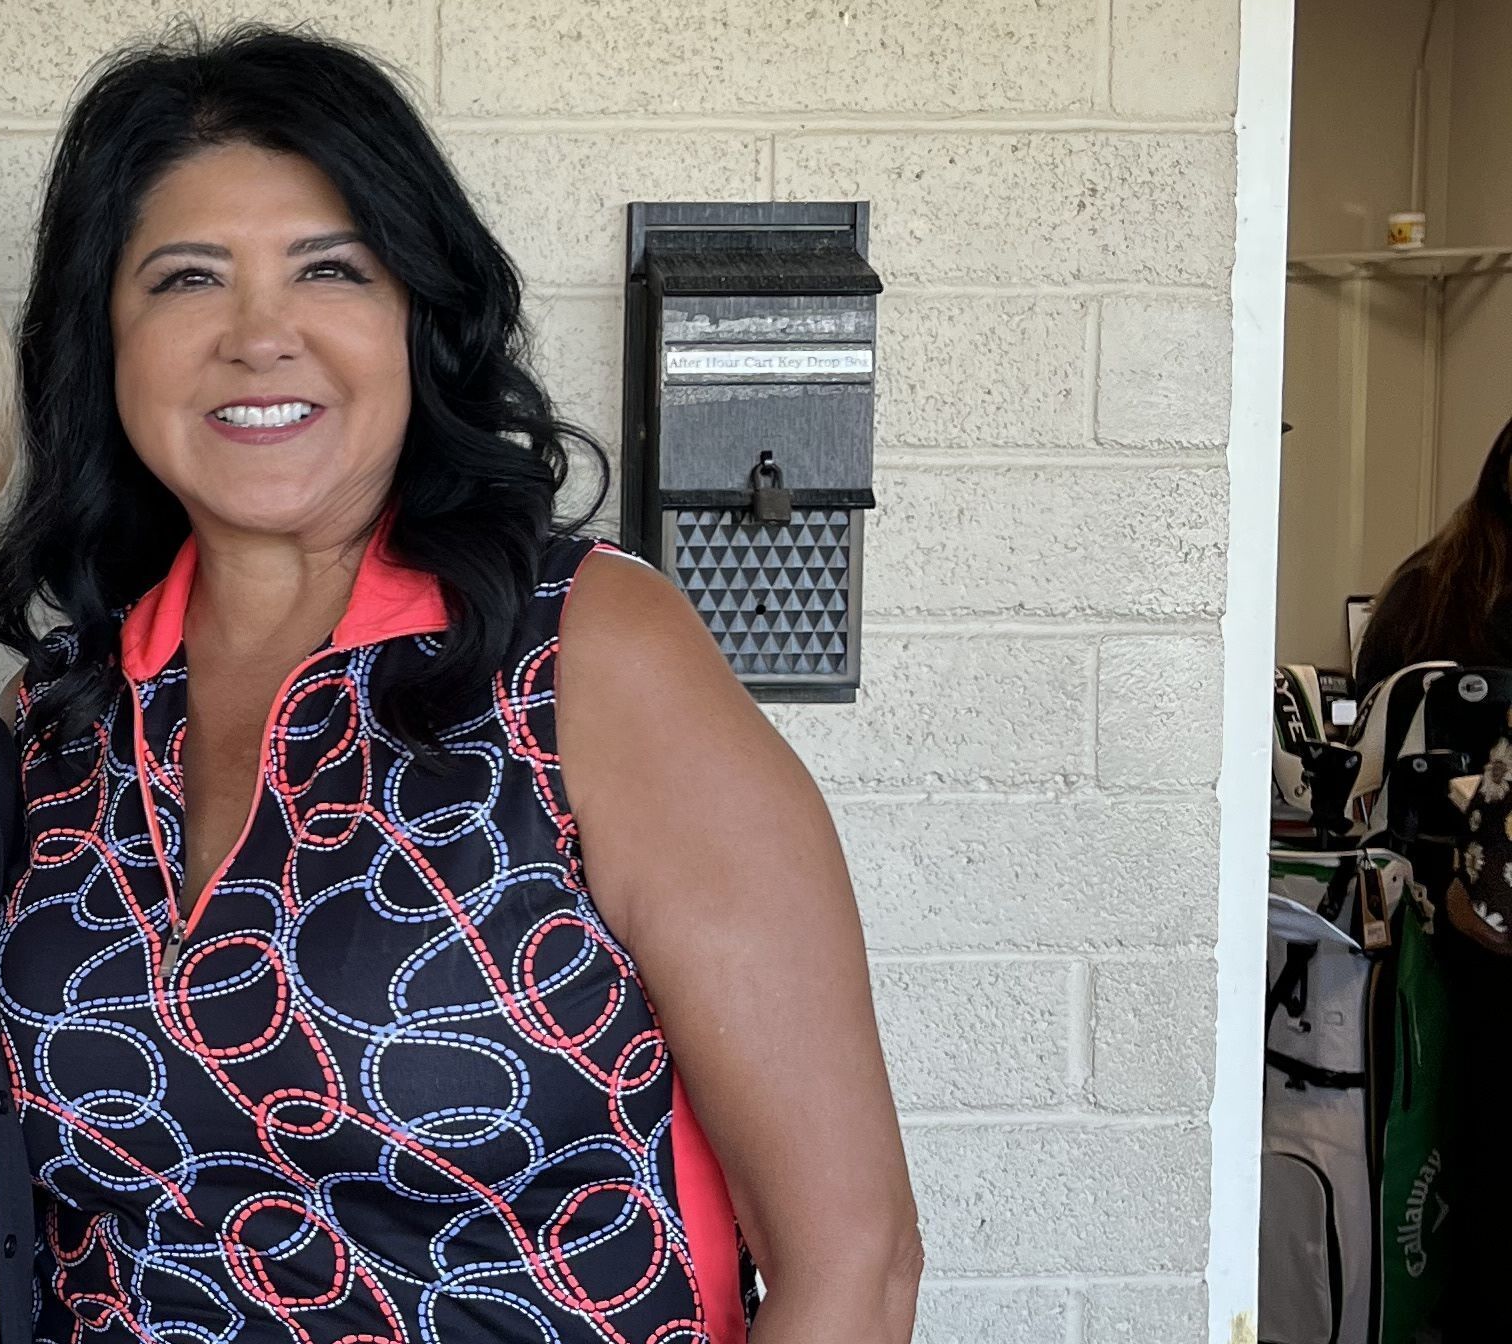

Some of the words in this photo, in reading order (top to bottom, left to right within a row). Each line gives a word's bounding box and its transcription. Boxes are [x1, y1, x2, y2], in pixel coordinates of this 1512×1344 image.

[669, 358, 702, 369] After
[706, 357, 739, 368] Hour
[744, 356, 773, 368] Cart
[778, 356, 803, 370] Key
[807, 356, 840, 370] Drop
[845, 356, 870, 368] Box
[1396, 1148, 1442, 1277] Callaway
